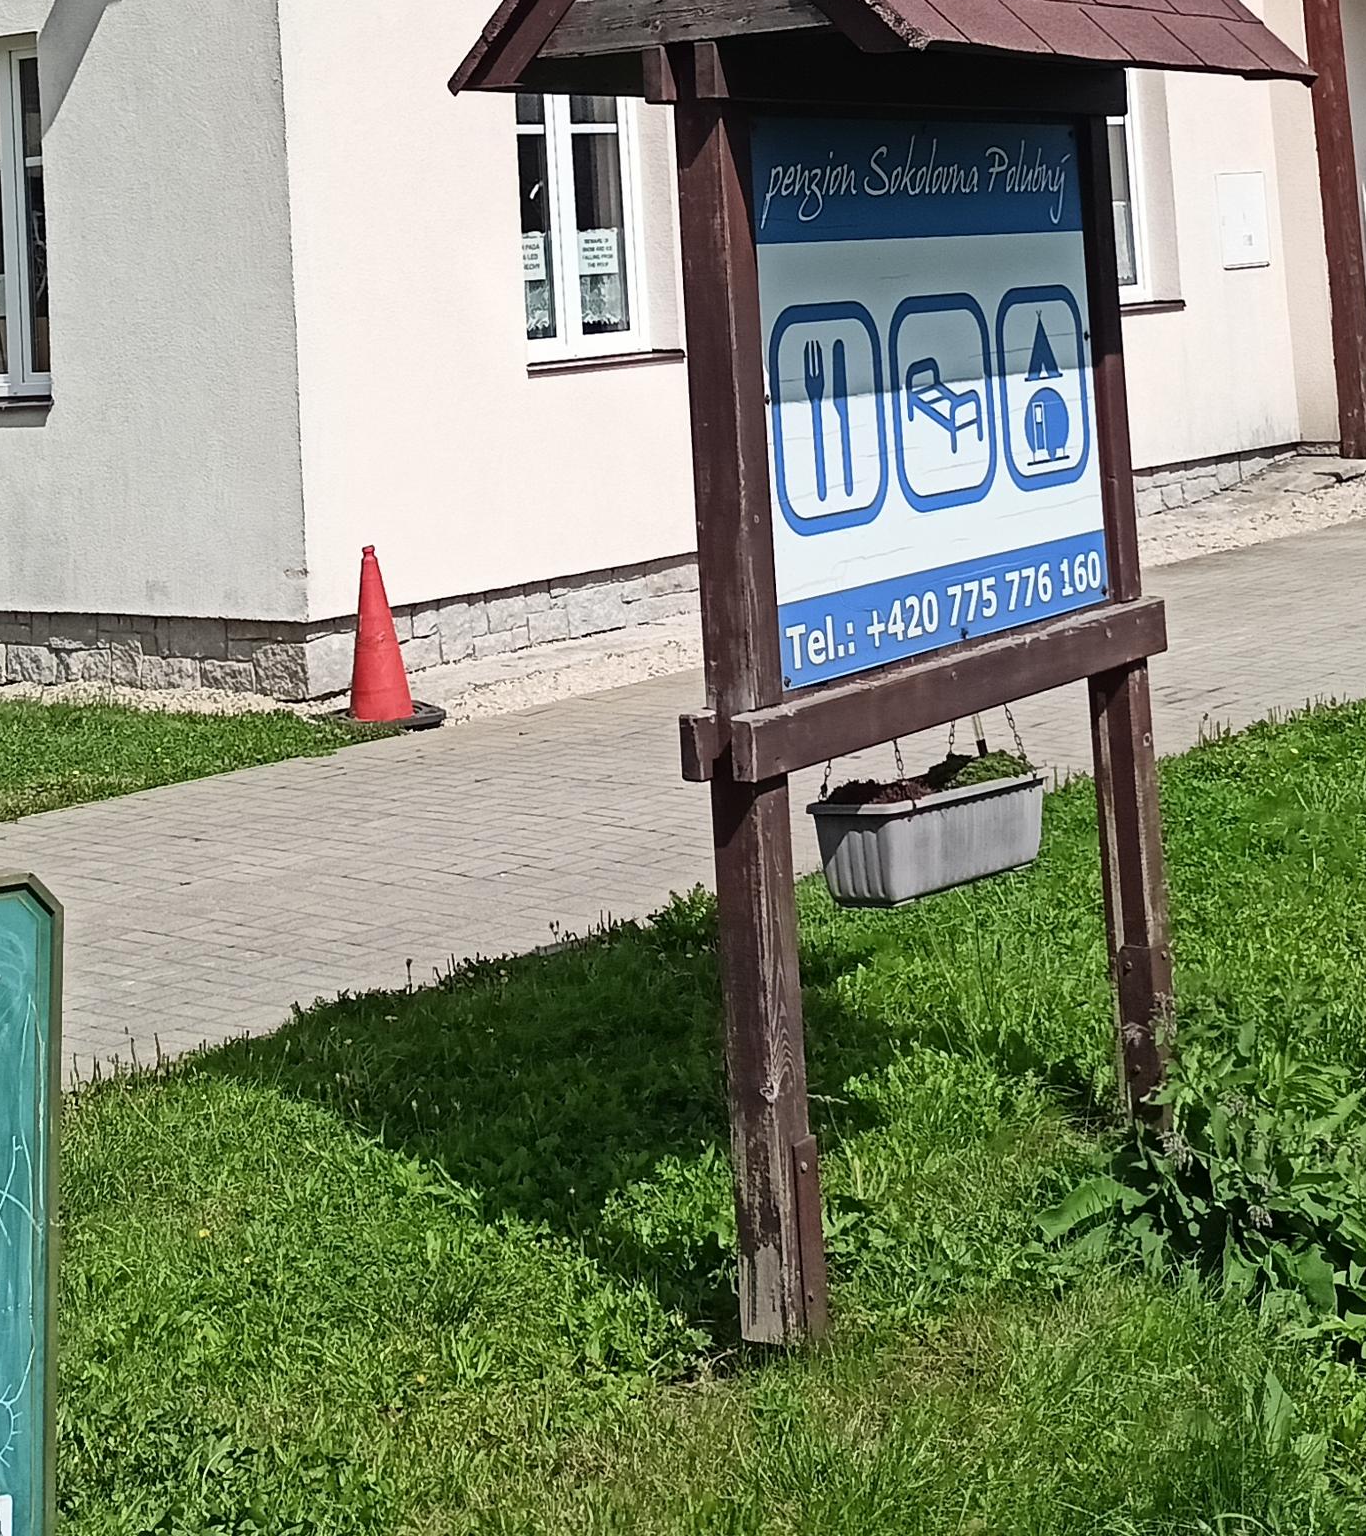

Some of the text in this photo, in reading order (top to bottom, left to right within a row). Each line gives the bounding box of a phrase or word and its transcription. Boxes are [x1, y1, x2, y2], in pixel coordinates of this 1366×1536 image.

[760, 134, 1072, 230] penzion Sokolovna Polubný
[785, 550, 1102, 671] Tel.: +420 775 776 160
